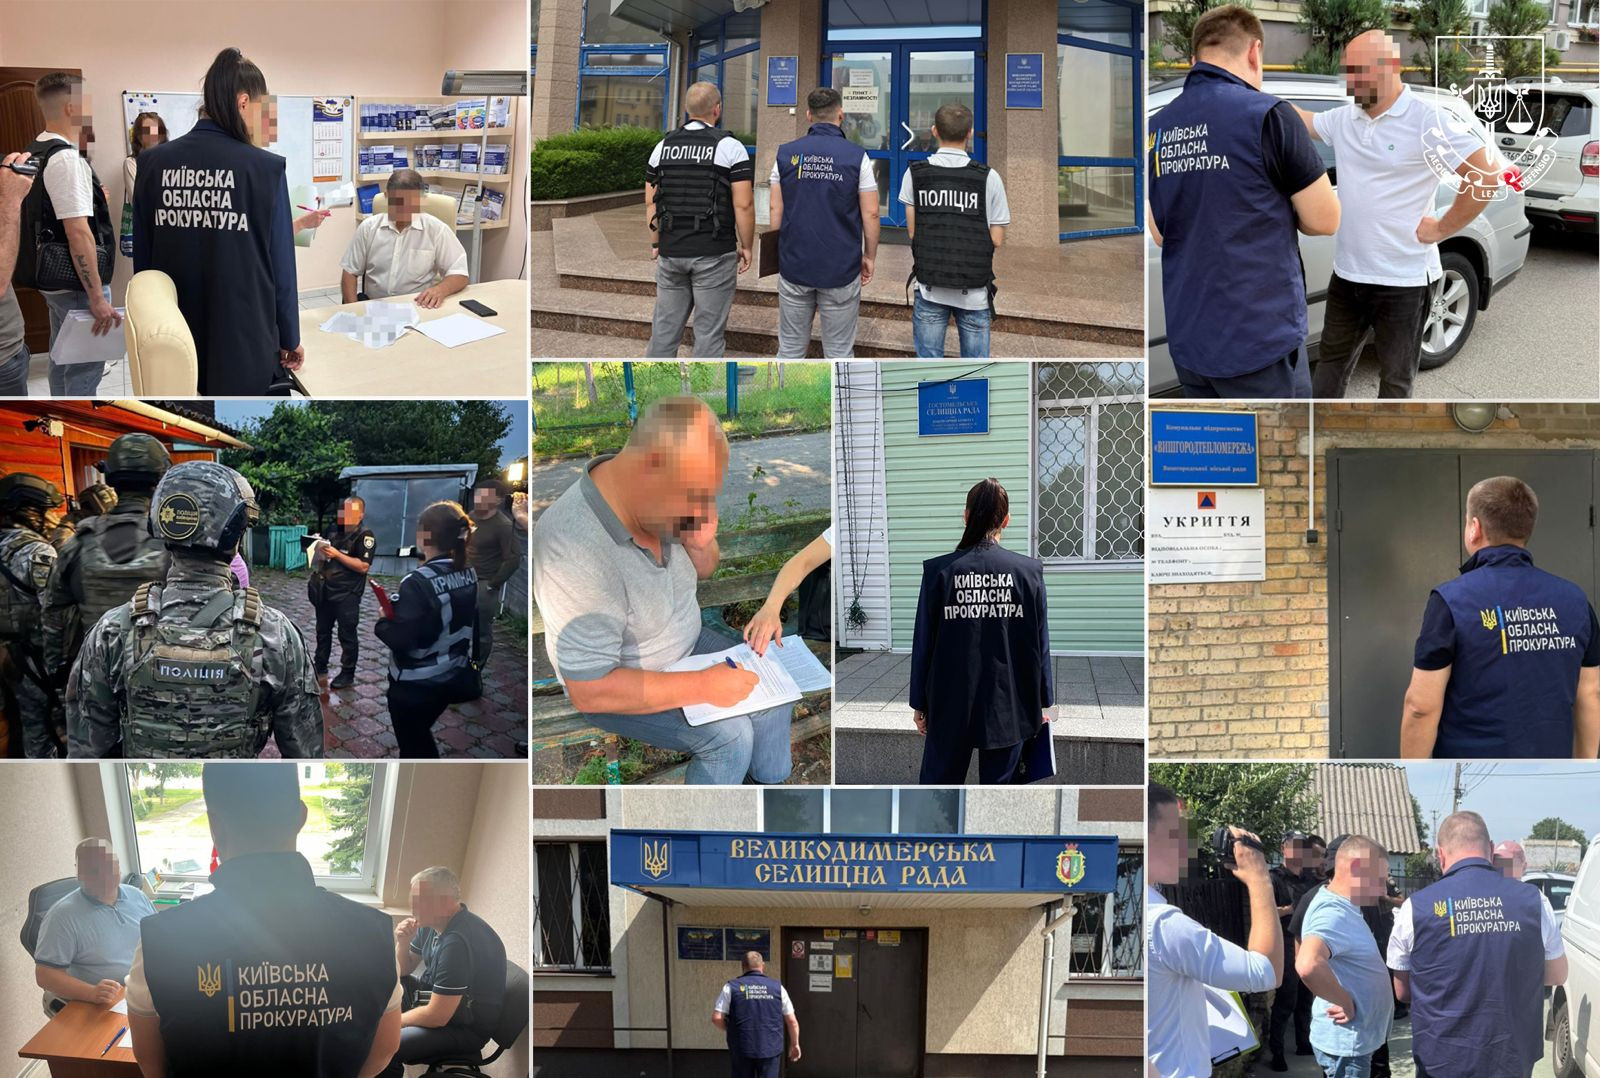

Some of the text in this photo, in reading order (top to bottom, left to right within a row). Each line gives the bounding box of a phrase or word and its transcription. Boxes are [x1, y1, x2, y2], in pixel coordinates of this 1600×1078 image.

[1162, 123, 1208, 144] КИЇВСЬКА
[662, 145, 714, 163] ПОЛІЦІЯ
[1161, 140, 1208, 158] ОБЛАСНА
[804, 155, 834, 164] КИЇВСЬКА
[1161, 155, 1230, 174] ПРОКУРАТУРА
[162, 166, 235, 188] КИЇВСЬКА
[802, 172, 844, 181] ПРОКУРАТУРА
[162, 190, 232, 209] ОБЛАСНА
[918, 190, 978, 212] ПОЛІЦІЯ
[1154, 440, 1254, 455] «ВИШГОРОДТЕПЛОМЕРЕЖА»
[1163, 516, 1250, 528] УКРИТТЯ
[954, 572, 1014, 588] КИЇВСЬКА
[956, 589, 1012, 603] ОБЛАСНА
[944, 604, 1024, 619] ПРОКУРАТУРА
[1505, 606, 1557, 622] КИЇВСЬКА
[1508, 622, 1559, 637] ОБЛАСНА
[1510, 636, 1576, 652] ПРОКУРАТУРА
[160, 665, 224, 679] ПОЛІЦІЯ
[730, 839, 996, 864] ВЕЛИКОДИМЕРСЬКА
[755, 864, 968, 888] СЕЛИЩНА РАДА
[1454, 897, 1503, 910] КИЇВСЬКА
[1456, 909, 1504, 922] ОБЛАСНА
[1457, 921, 1520, 935] ПРОКУРАТУРА
[239, 961, 329, 985] КИЇВСЬКА
[240, 987, 328, 1008] ОБЛАСНА
[240, 1006, 353, 1030] ПРОКУРАТУРА
